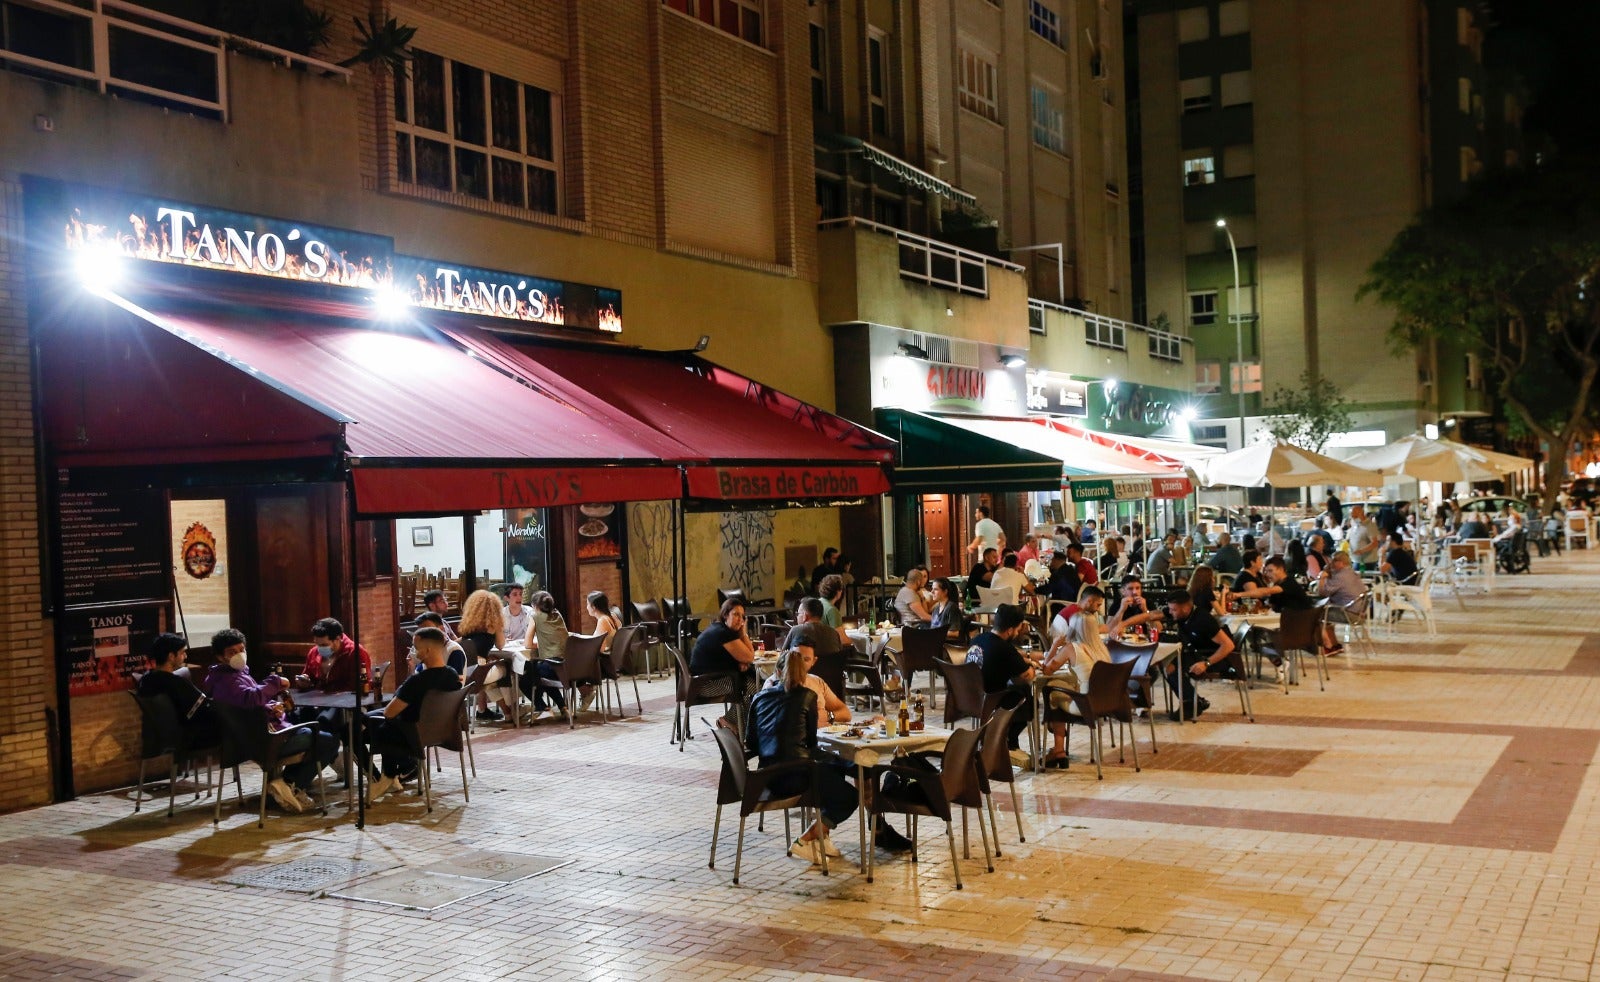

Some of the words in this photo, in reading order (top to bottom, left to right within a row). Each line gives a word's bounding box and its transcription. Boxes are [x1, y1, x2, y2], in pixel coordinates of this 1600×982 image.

[926, 365, 987, 400] GIANNI
[718, 471, 771, 497] Brasa
[776, 470, 798, 495] de
[801, 469, 858, 495] Carbón
[1115, 480, 1153, 497] gianni
[1160, 480, 1183, 493] pizzeria
[1075, 485, 1109, 498] ristorante
[88, 613, 133, 629] TANO'S
